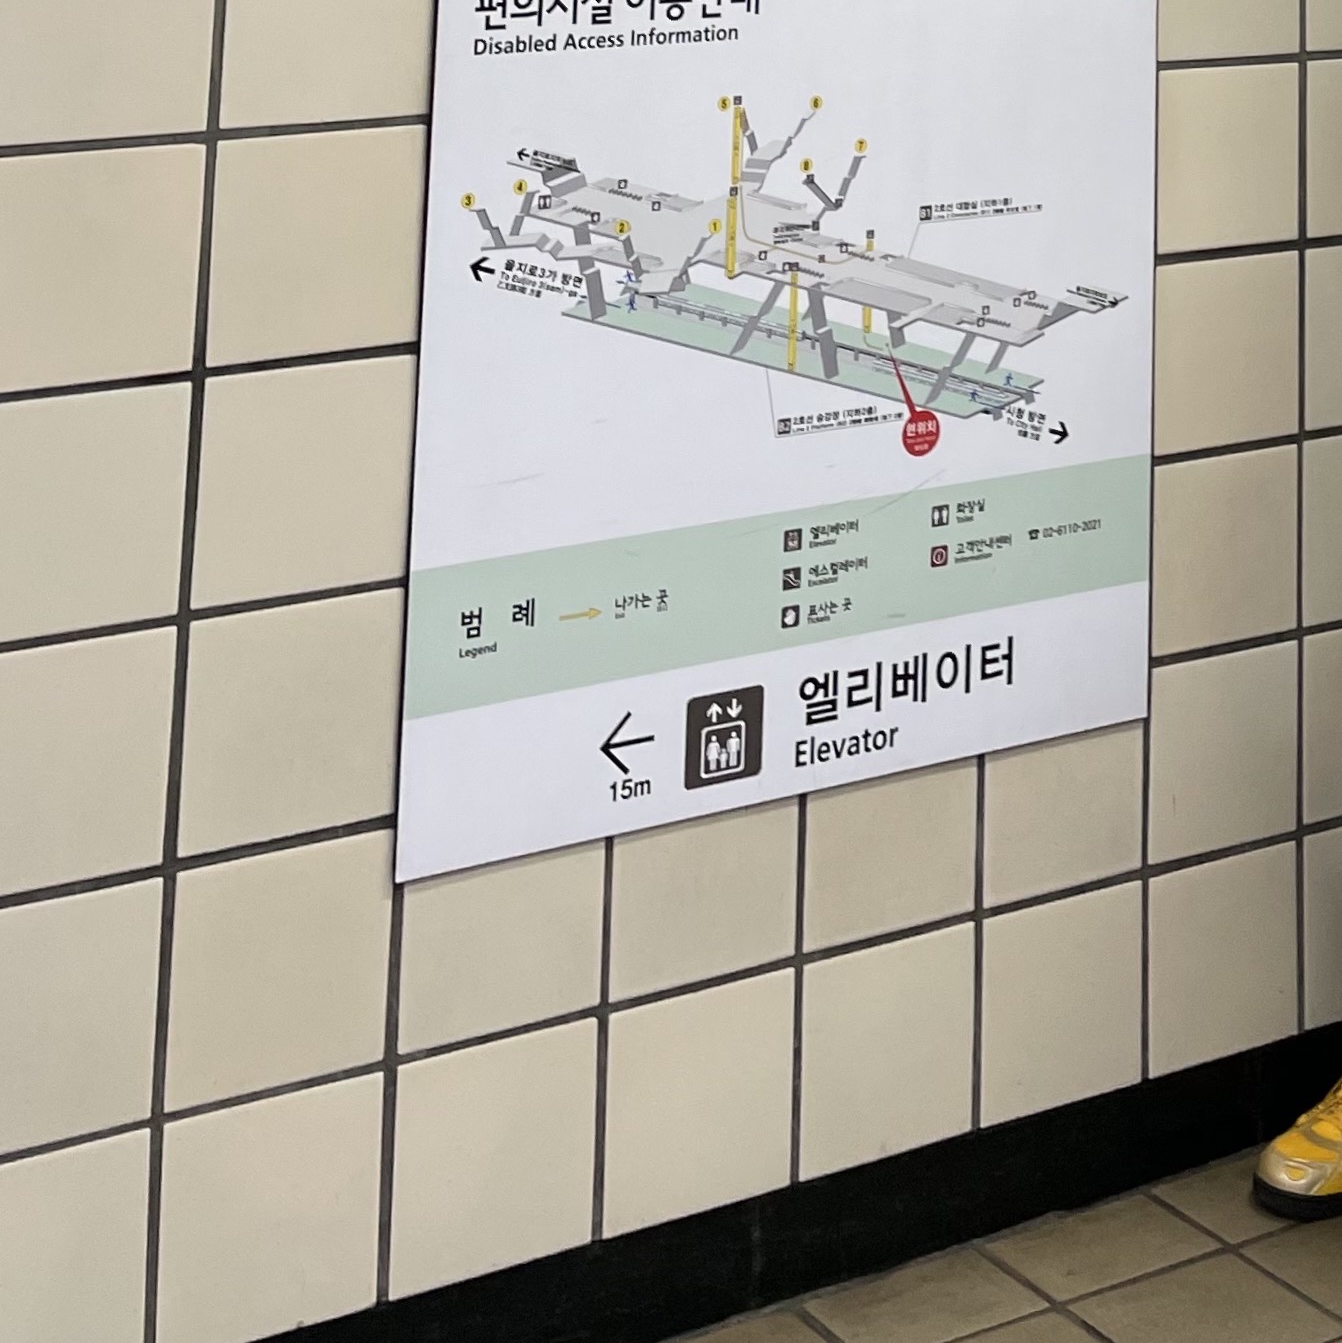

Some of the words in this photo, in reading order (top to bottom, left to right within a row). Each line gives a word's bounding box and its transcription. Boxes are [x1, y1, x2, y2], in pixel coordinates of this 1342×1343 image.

[473, 32, 557, 56] Disabled
[563, 32, 625, 51] Access
[630, 23, 739, 47] Information
[614, 593, 653, 612] 나가는
[655, 589, 669, 607] 곳
[458, 641, 498, 659] Legend
[799, 635, 1015, 727] 엘리베이터
[794, 724, 900, 769] Elevator
[608, 777, 653, 803] 15m
